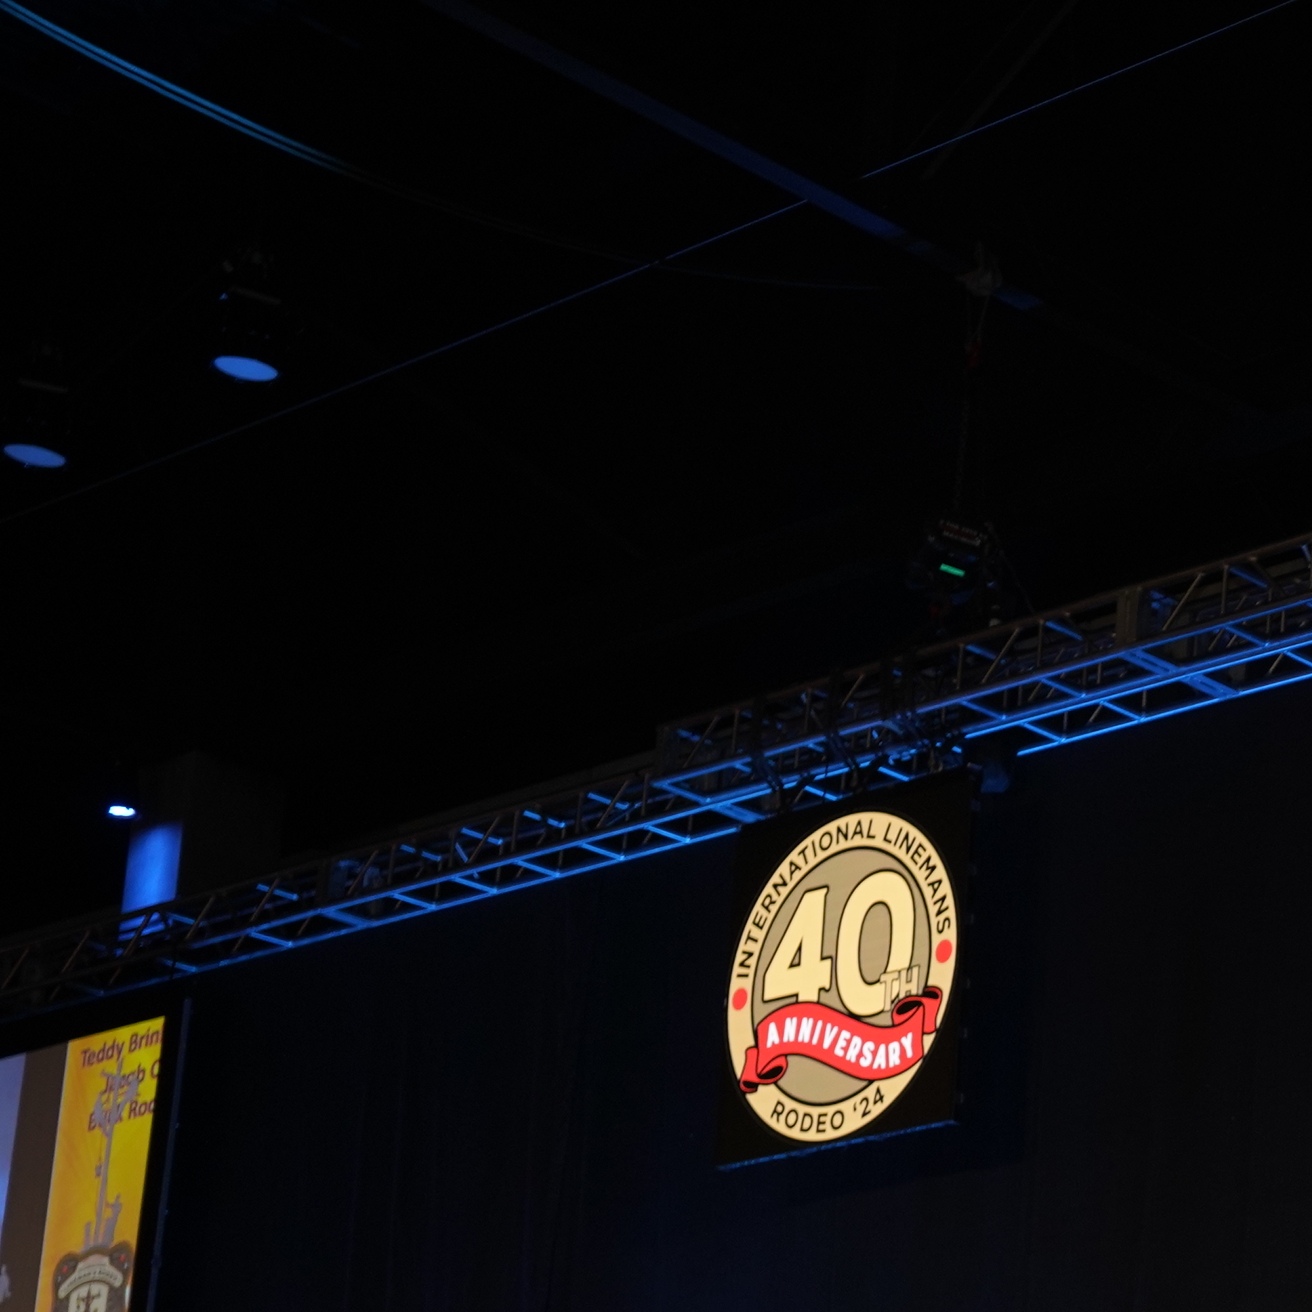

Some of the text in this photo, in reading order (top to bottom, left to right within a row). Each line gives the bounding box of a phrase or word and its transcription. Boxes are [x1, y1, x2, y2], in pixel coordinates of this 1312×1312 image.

[737, 818, 952, 979] INTERNATIONAL LINEMANS
[82, 1027, 164, 1068] Teddy Brin
[766, 1017, 914, 1070] ANNIVERSARY
[770, 1100, 845, 1133] RODEO
